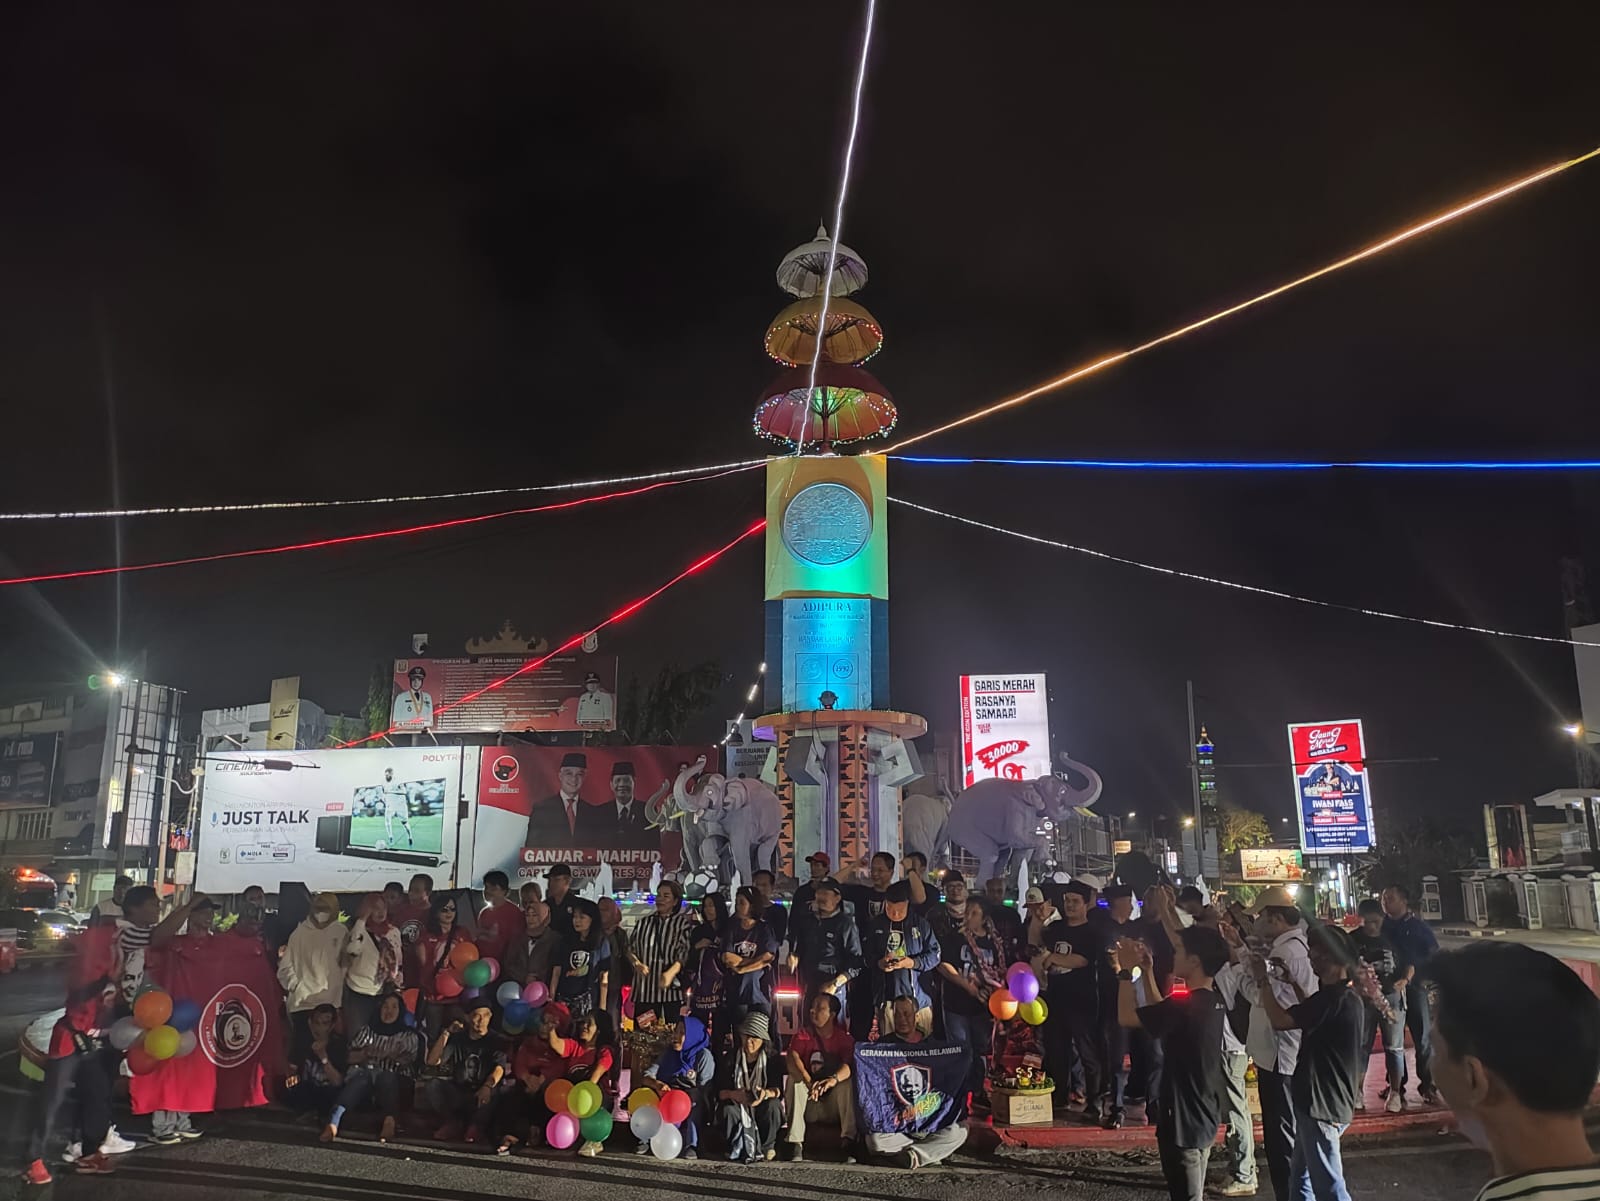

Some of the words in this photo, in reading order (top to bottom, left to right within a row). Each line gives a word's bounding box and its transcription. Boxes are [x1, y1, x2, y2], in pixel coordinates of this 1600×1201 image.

[801, 602, 852, 612] ADIPURA
[975, 680, 1001, 691] GARIS
[1002, 679, 1035, 691] MERAH
[975, 695, 1016, 707] RASANYA
[976, 708, 1017, 719] SAMAAA!
[422, 753, 472, 762] POLYTRN
[1312, 799, 1334, 808] IWAN
[222, 811, 263, 826] JUST
[267, 809, 310, 825] TALK
[524, 850, 584, 862] GANJAR
[597, 850, 661, 863] MAHFUD
[860, 1048, 893, 1057] GERAKAN
[894, 1048, 929, 1057] NASIONAL
[929, 1046, 962, 1056] RELAWAN
